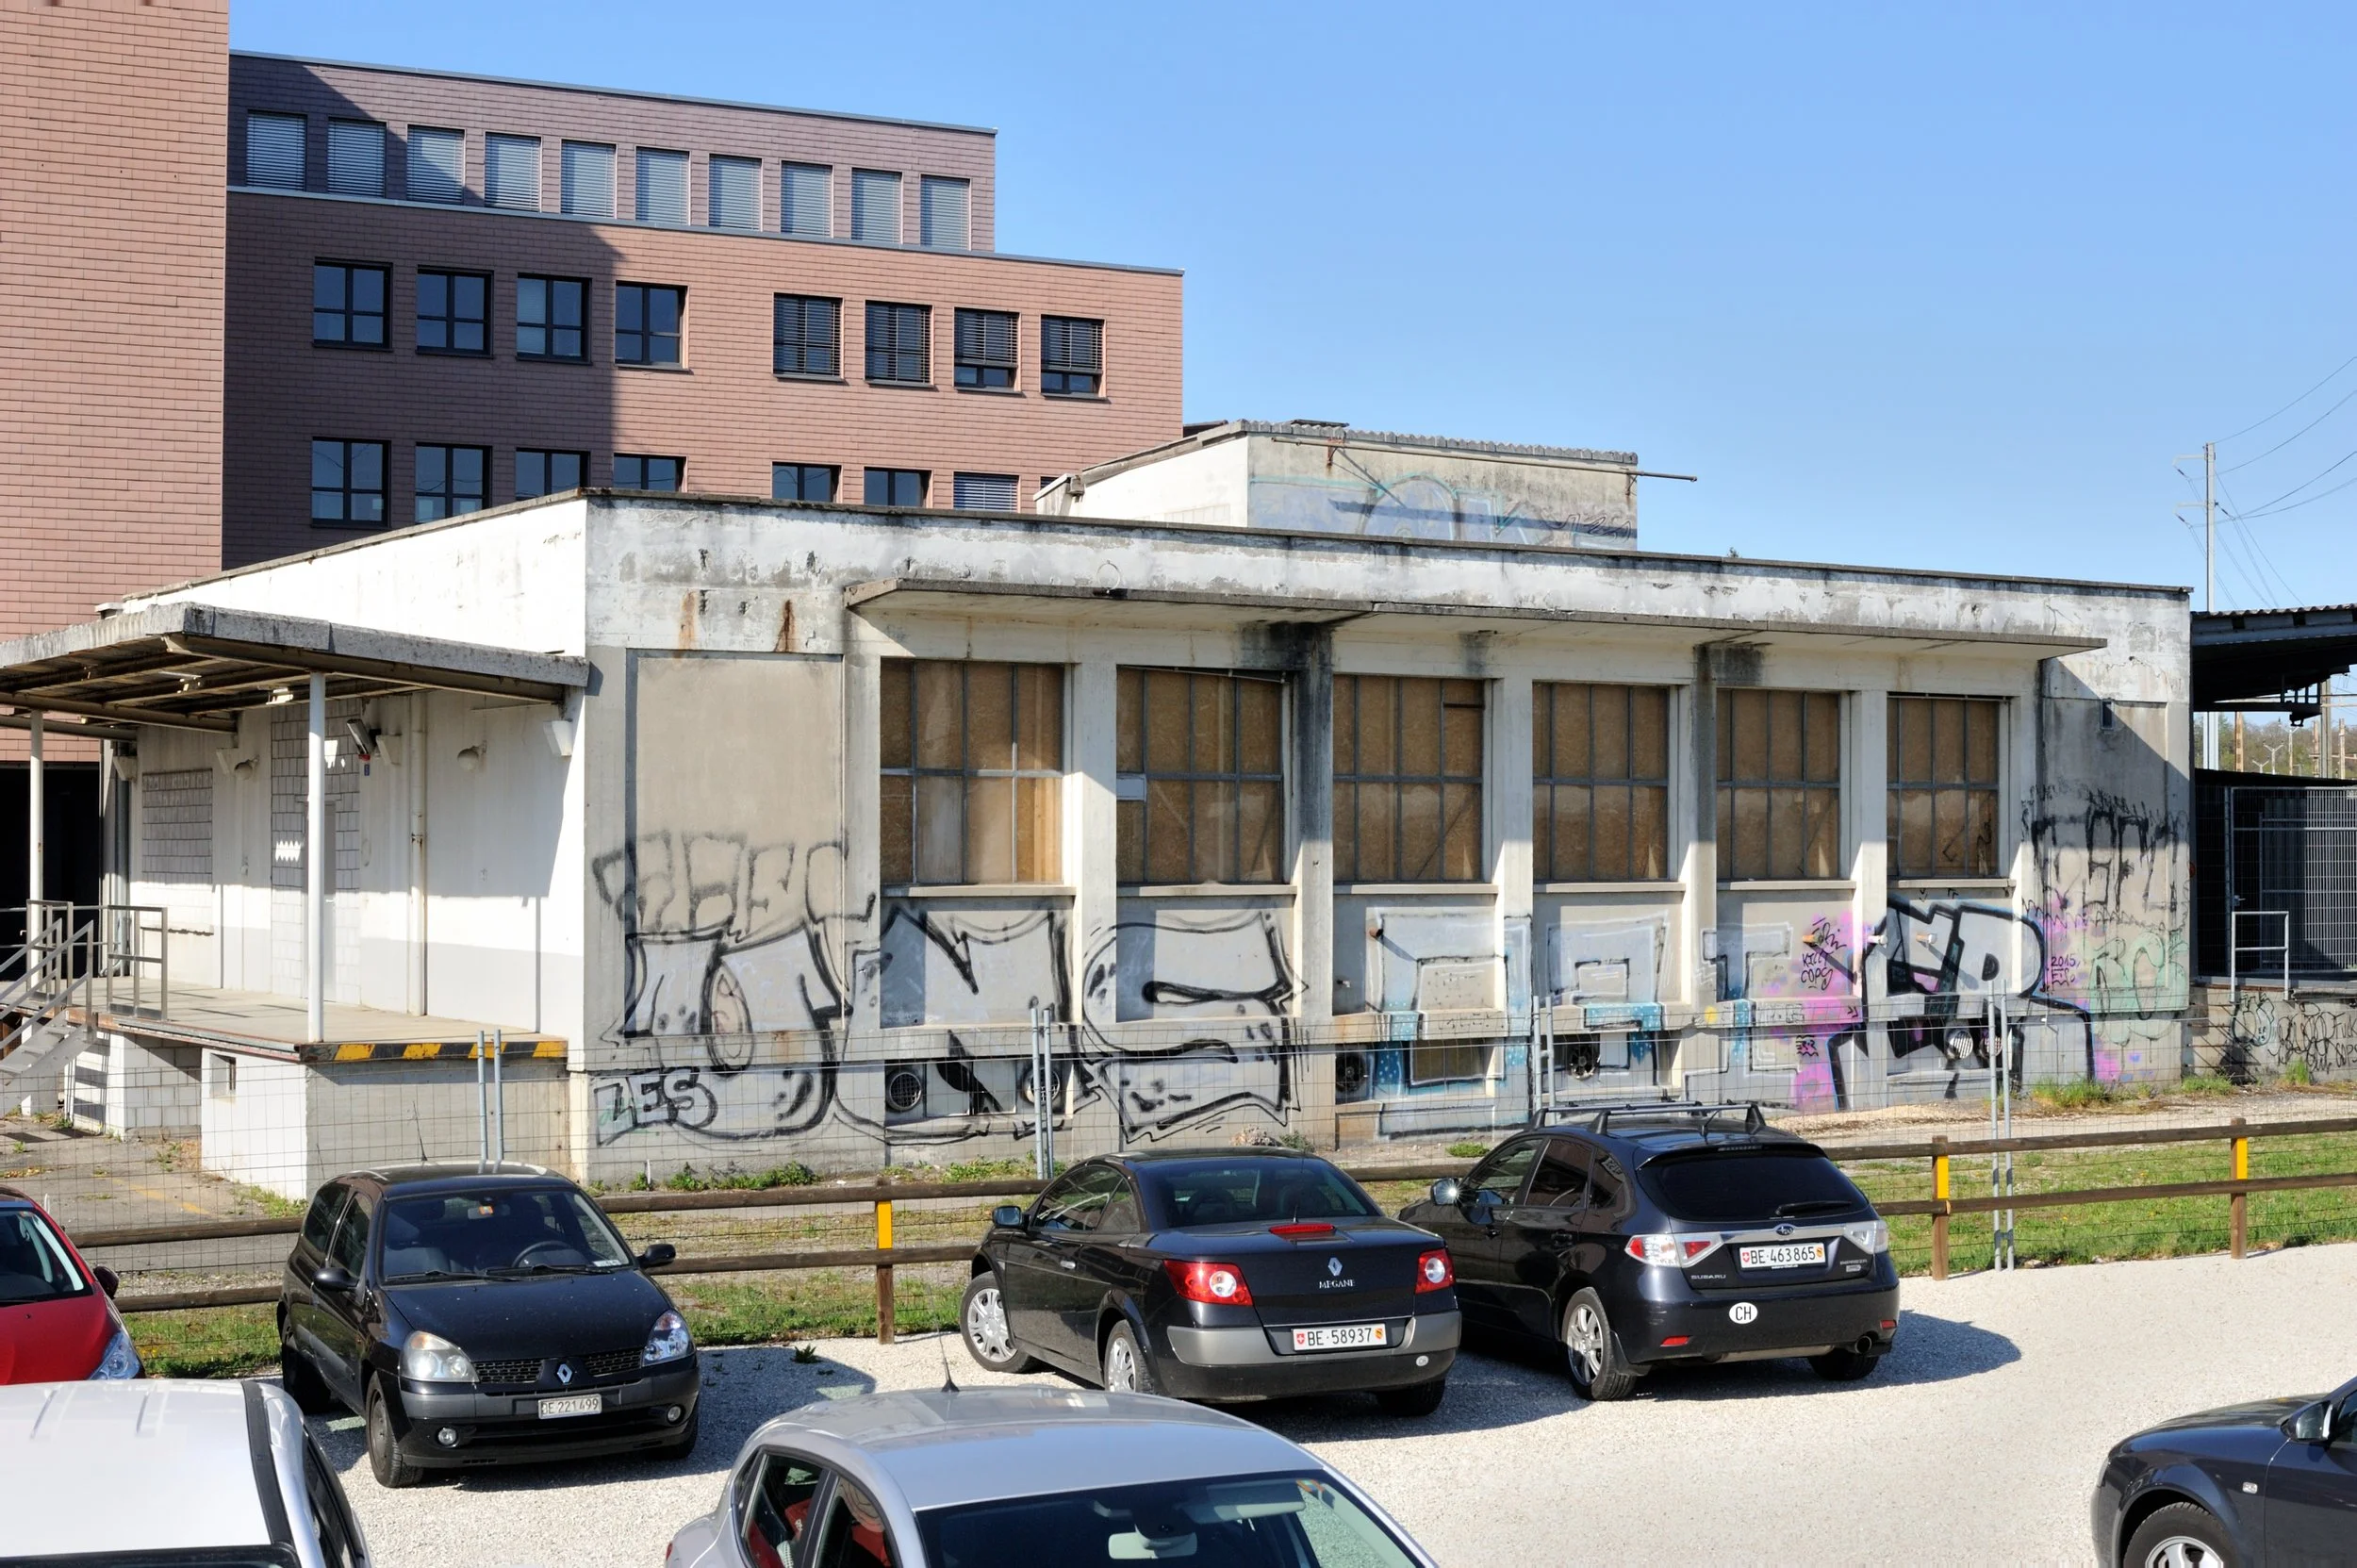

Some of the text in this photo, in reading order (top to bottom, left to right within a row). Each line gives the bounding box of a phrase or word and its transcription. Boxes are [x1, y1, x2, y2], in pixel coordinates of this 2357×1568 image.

[1750, 1246, 1816, 1264] BE 463865
[1318, 1279, 1356, 1289] MEGANE
[1735, 1306, 1752, 1321] CH
[1307, 1328, 1372, 1346] BE 58937
[557, 1398, 599, 1413] 221499
